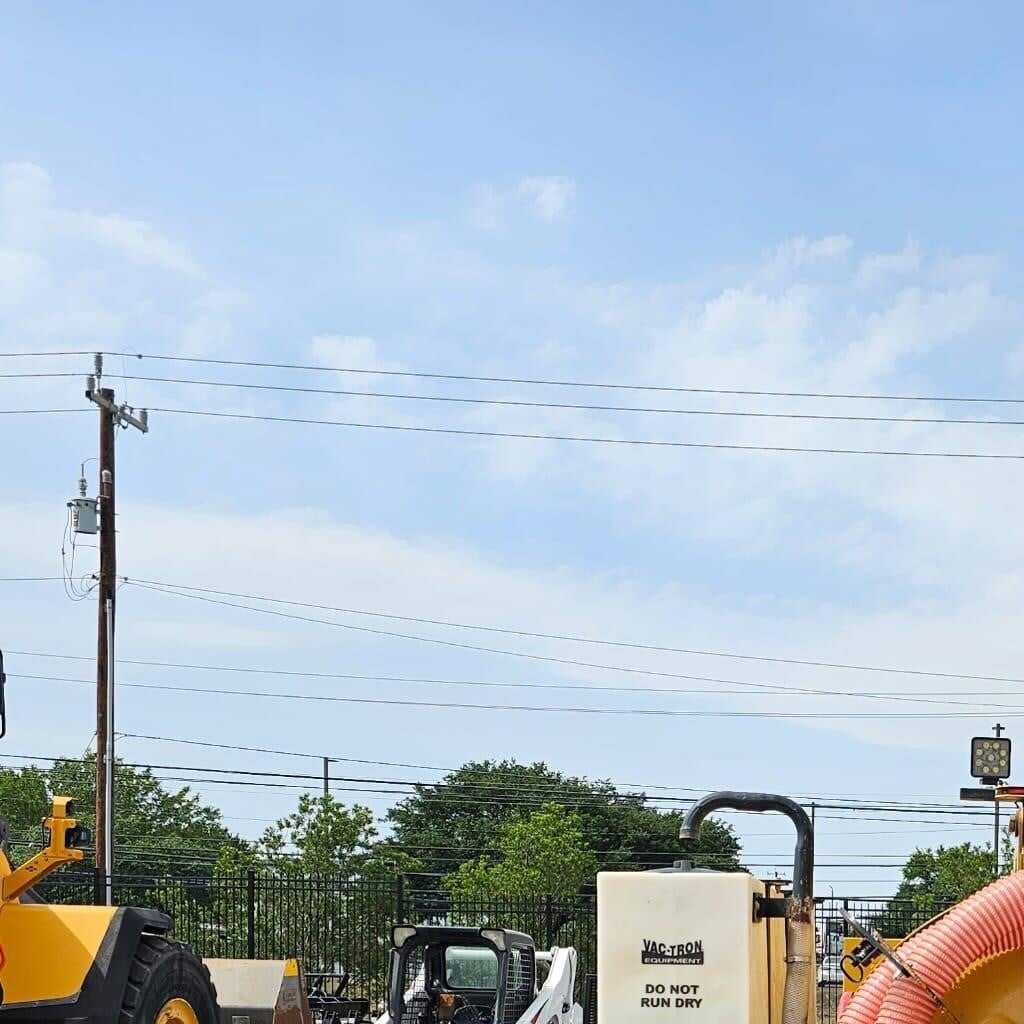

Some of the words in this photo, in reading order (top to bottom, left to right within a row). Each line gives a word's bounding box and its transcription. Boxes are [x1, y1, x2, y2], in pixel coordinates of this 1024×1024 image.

[643, 939, 702, 956] VAC-TRON
[645, 984, 665, 994] DO
[670, 984, 699, 994] NOT
[641, 997, 671, 1008] RUN
[675, 998, 703, 1008] DRY
